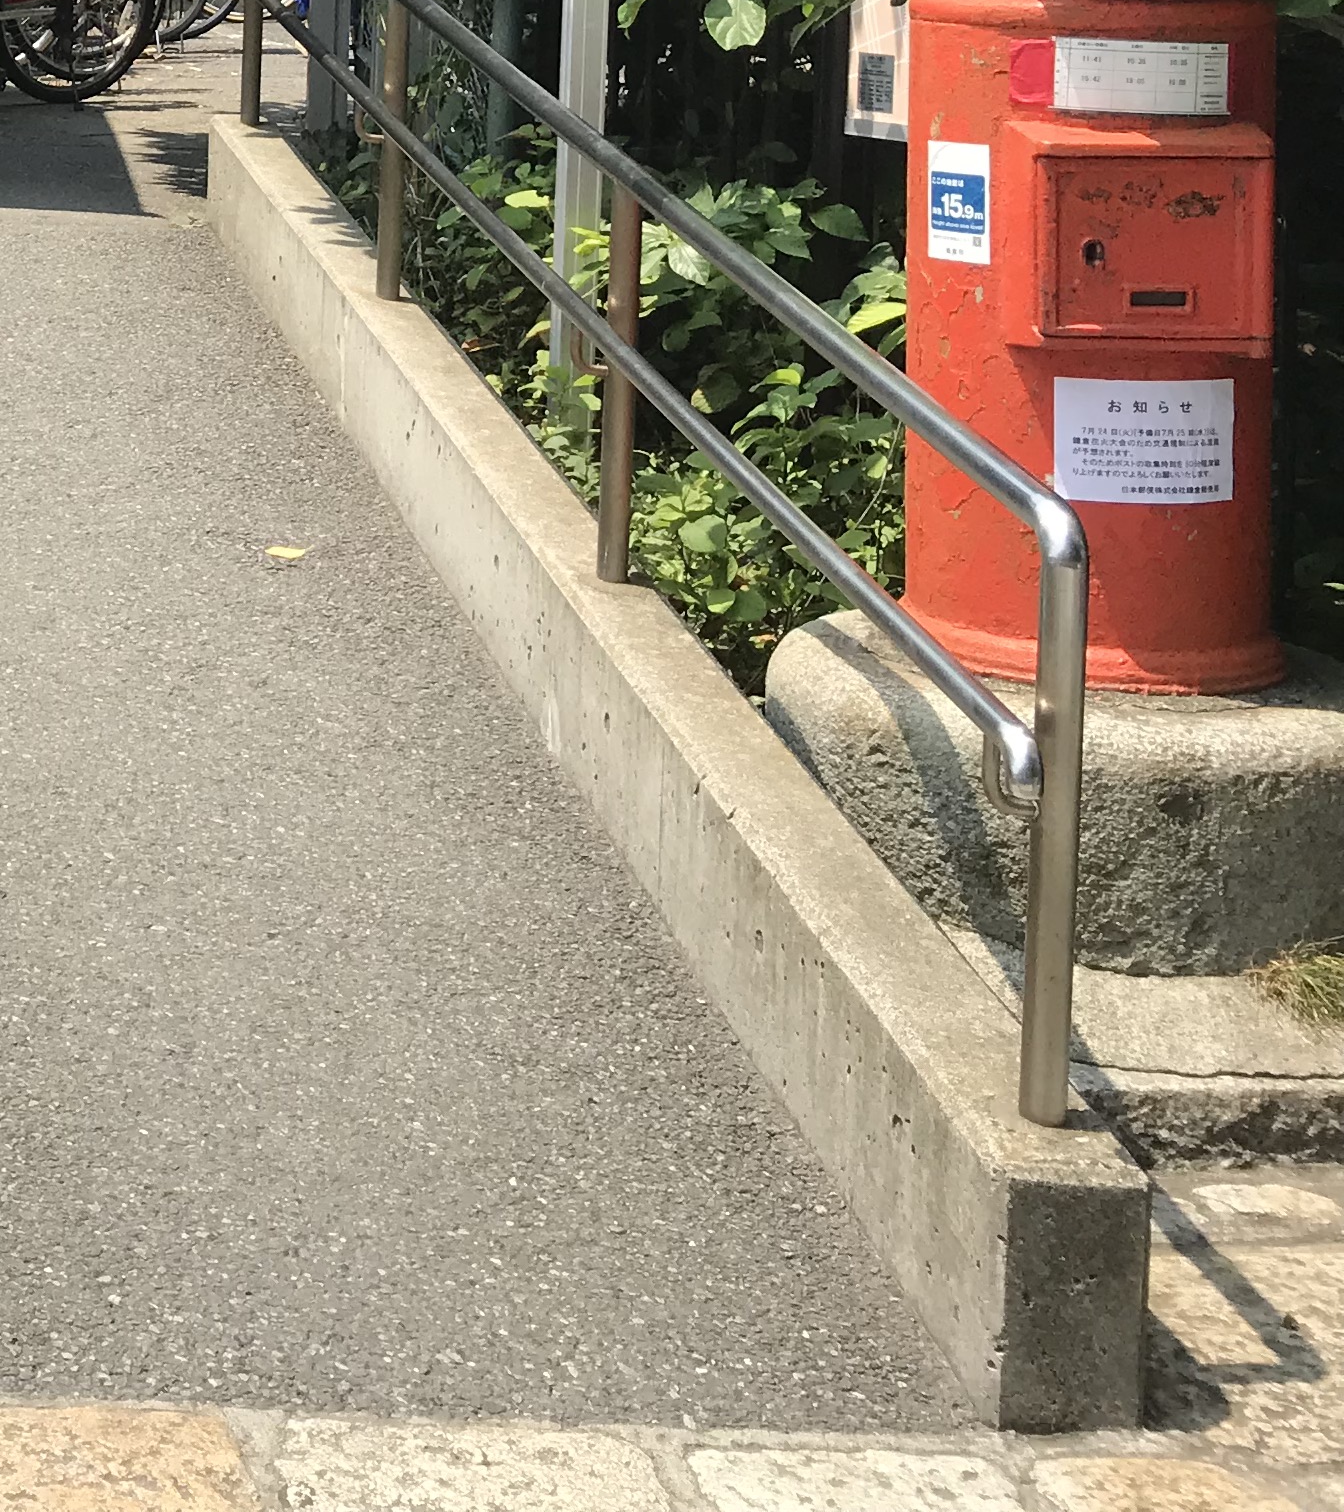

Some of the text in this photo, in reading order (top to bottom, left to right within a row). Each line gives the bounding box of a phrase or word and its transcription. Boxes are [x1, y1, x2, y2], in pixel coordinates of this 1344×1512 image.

[941, 193, 984, 220] 15.9m
[1107, 399, 1193, 414] お知らせ
